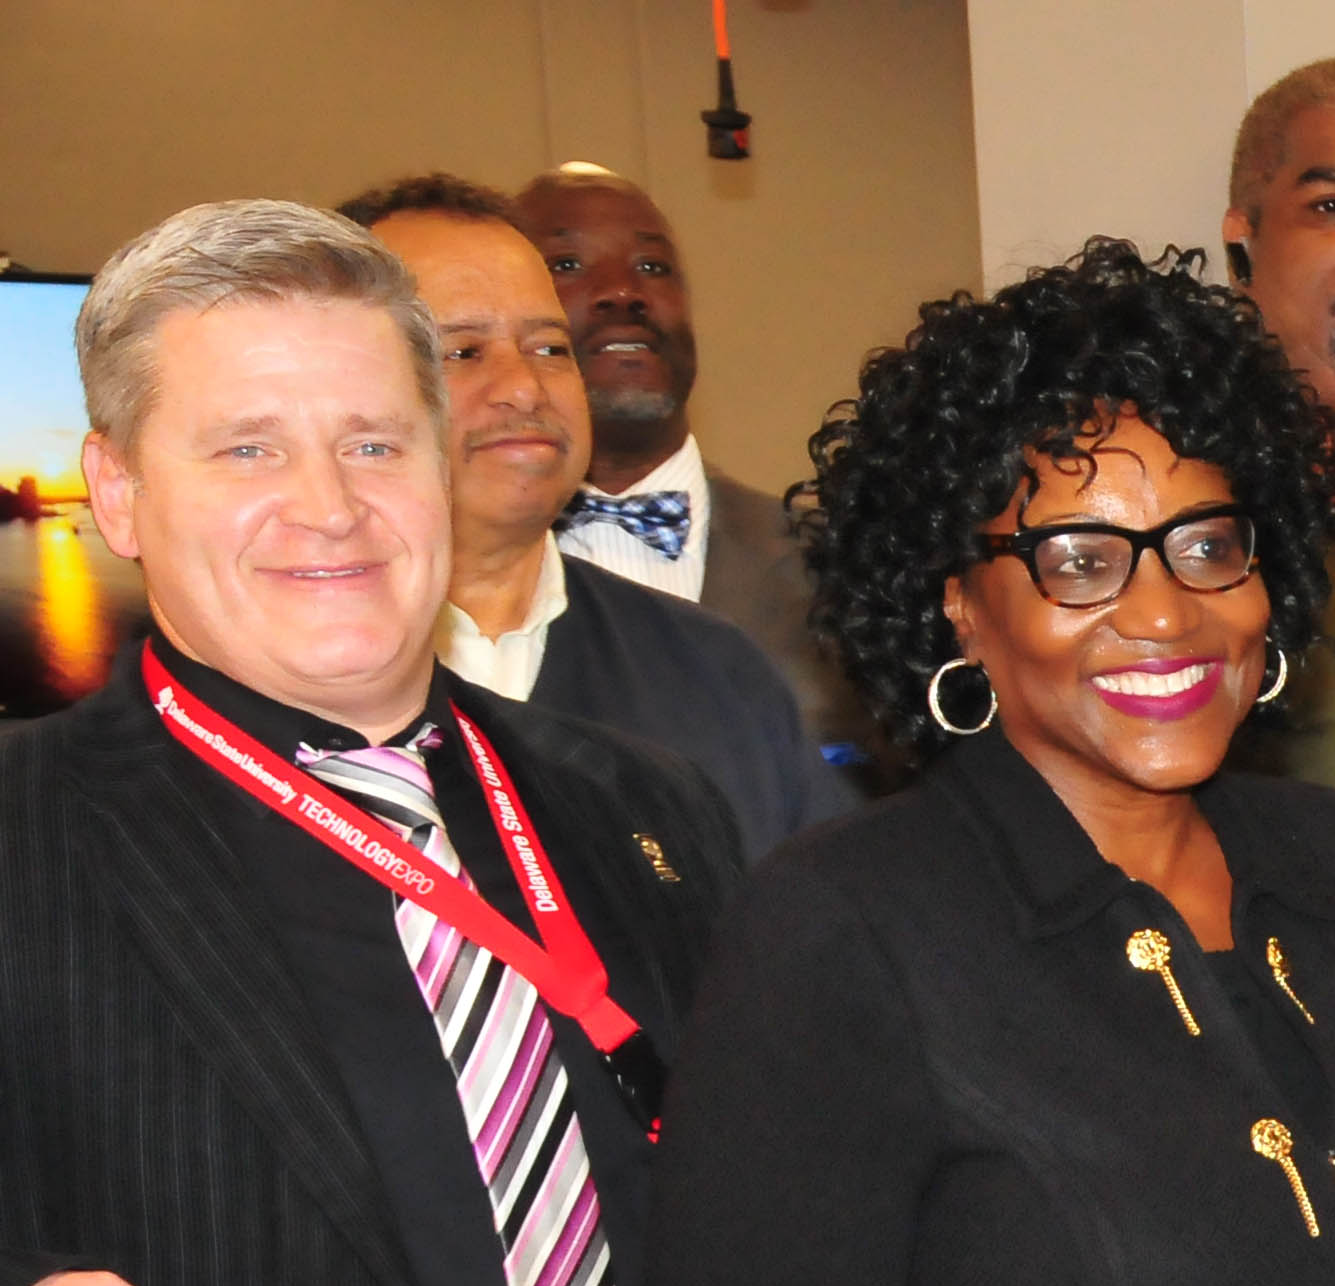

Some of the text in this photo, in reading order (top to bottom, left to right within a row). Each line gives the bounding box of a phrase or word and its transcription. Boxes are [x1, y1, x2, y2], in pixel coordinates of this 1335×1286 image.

[297, 794, 434, 895] TECHNOLOGYEXPO
[457, 716, 559, 912] Delaware State University
